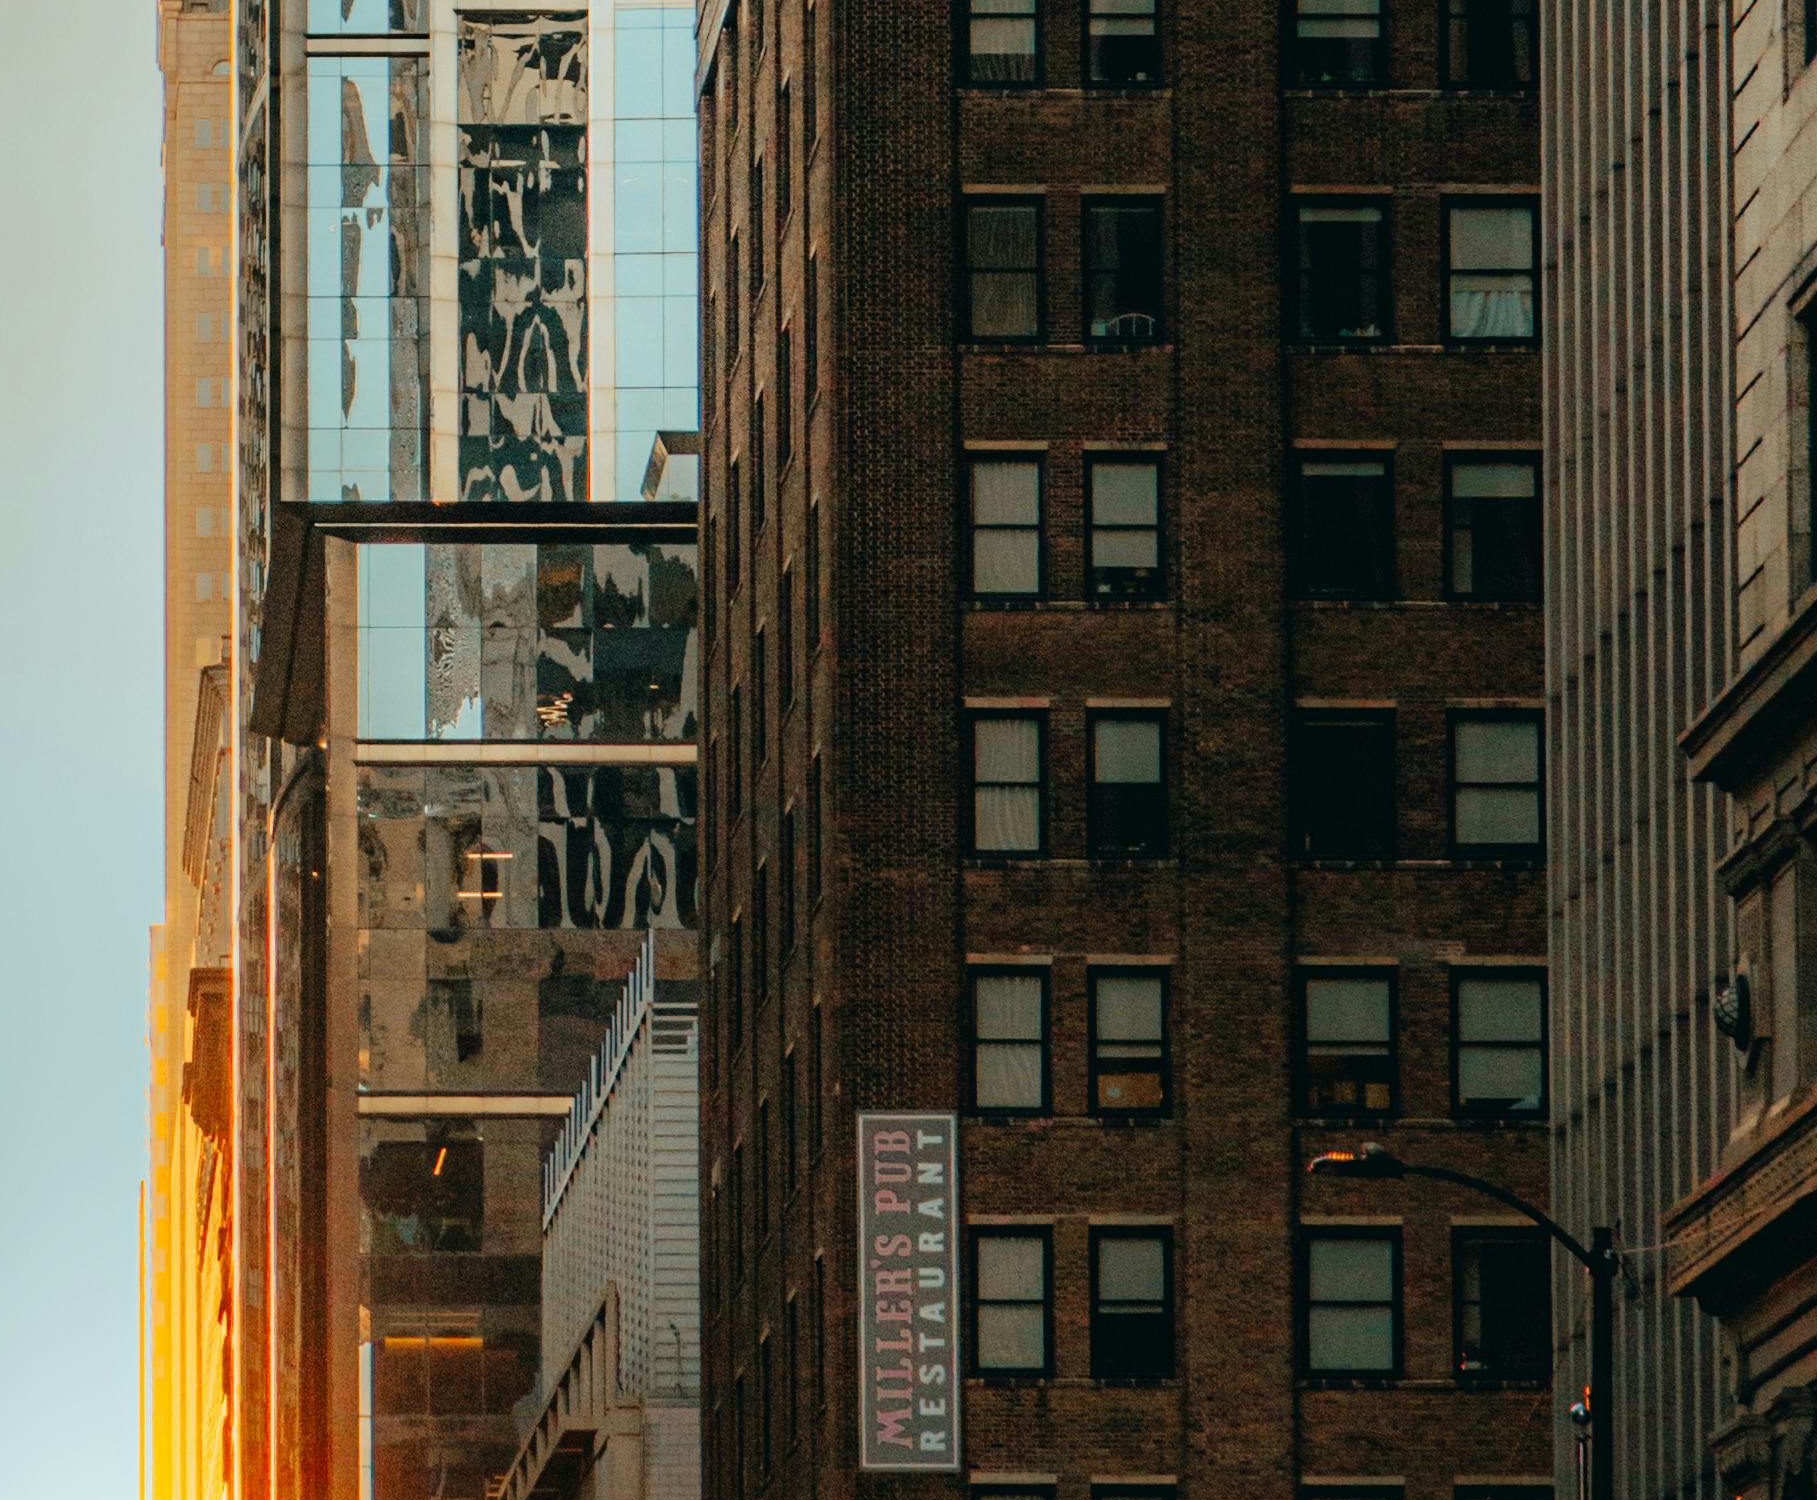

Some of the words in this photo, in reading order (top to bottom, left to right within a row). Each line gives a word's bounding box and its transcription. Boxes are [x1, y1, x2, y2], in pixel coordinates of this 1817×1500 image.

[874, 1129, 912, 1214] PUB
[871, 1233, 913, 1449] MILLER'S
[917, 1129, 945, 1453] RESTAURANT
